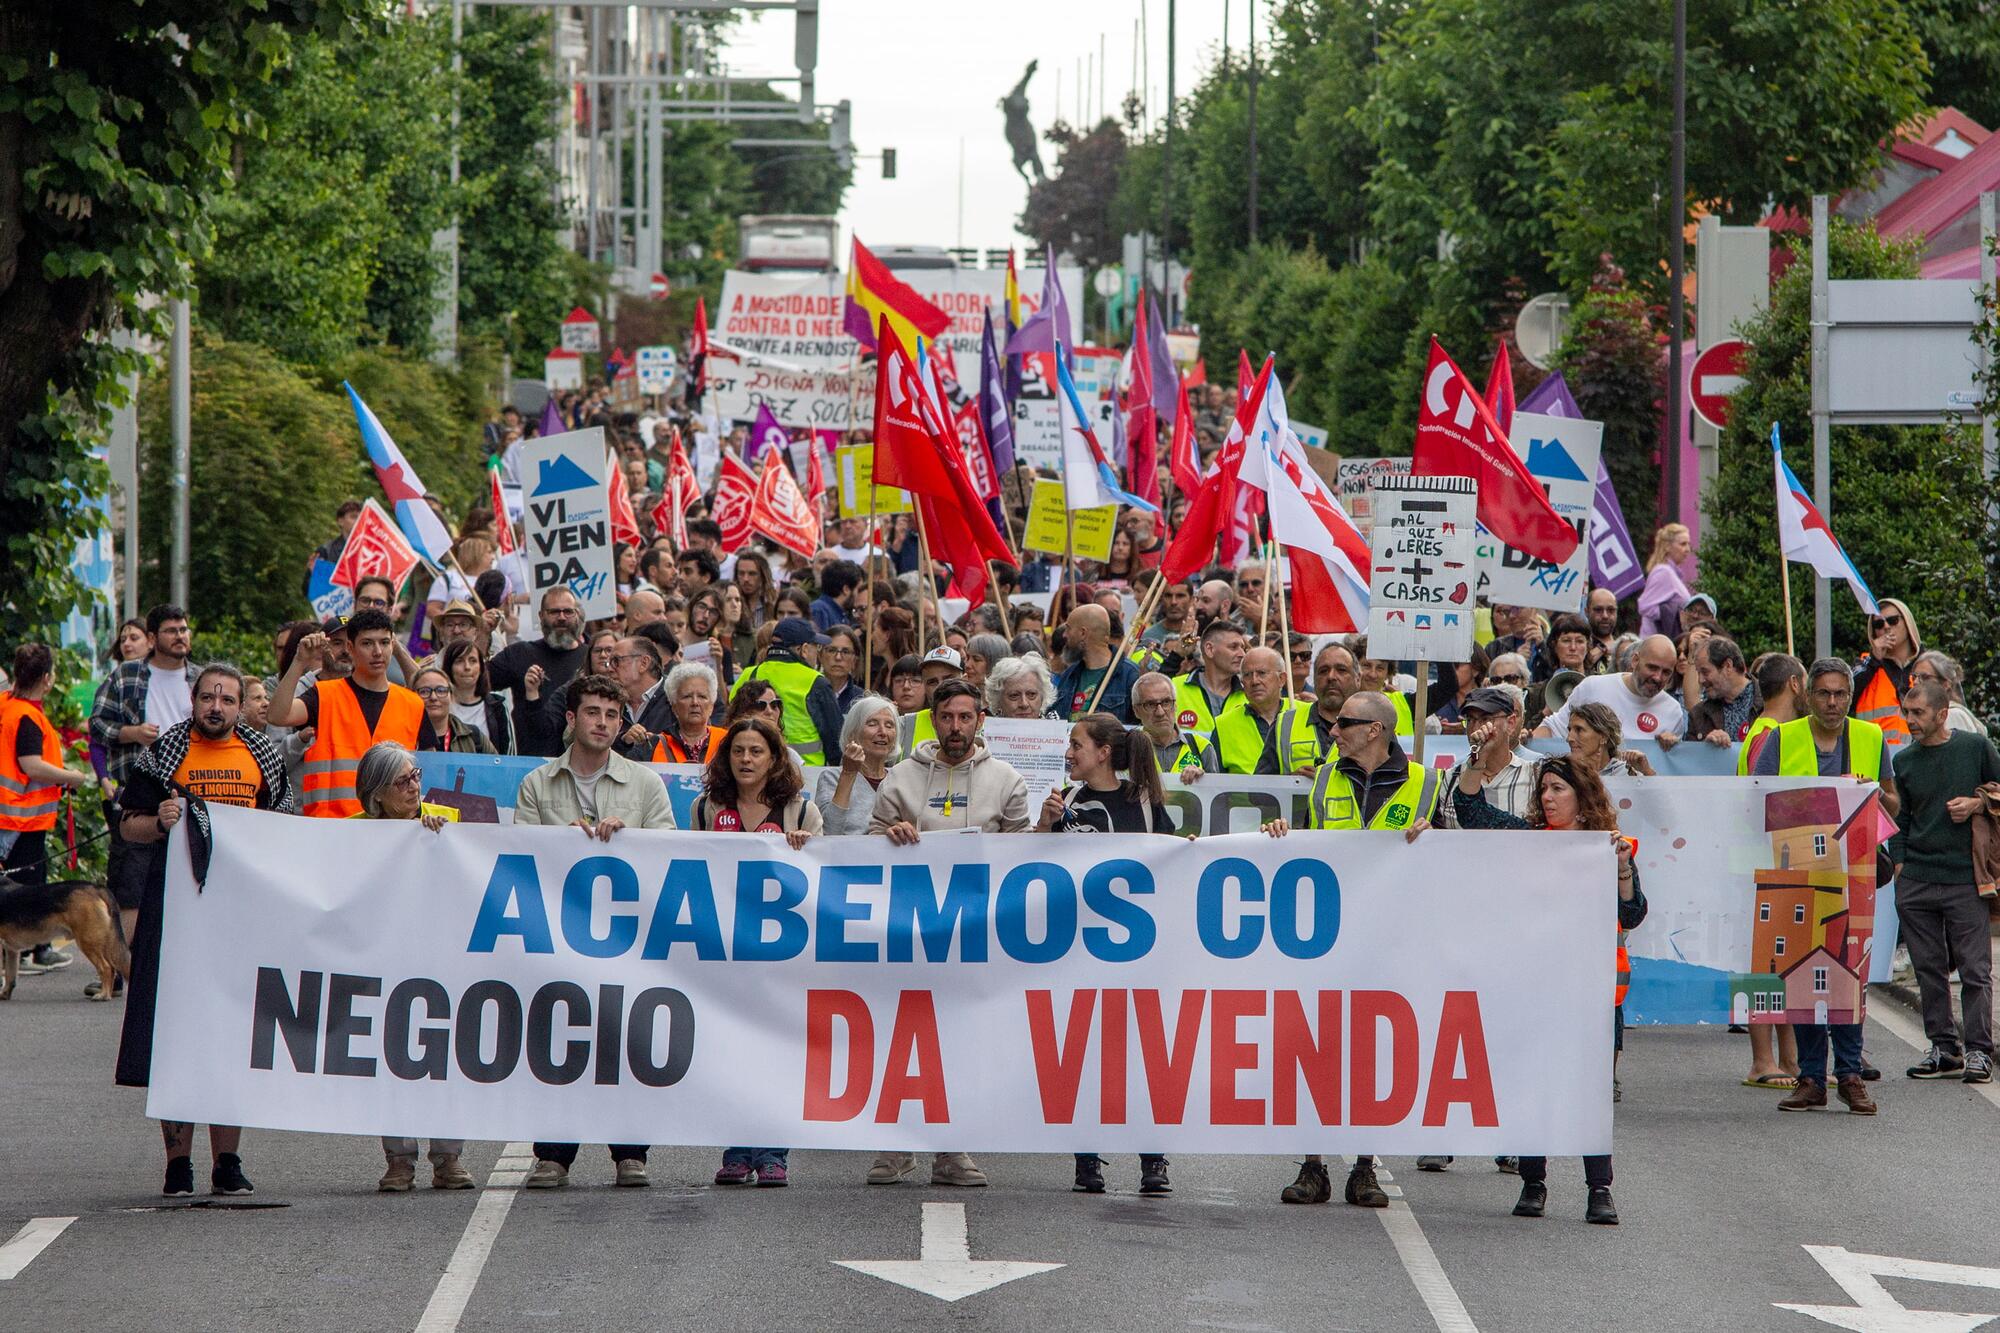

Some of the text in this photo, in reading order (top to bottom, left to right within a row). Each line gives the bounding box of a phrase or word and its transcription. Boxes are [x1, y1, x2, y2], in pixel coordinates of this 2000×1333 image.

[732, 294, 743, 313] A
[727, 316, 791, 336] CONTRA
[796, 317, 807, 337] O
[1340, 463, 1369, 478] CASAS
[1492, 456, 1515, 479] Galega
[530, 498, 566, 528] VI
[1408, 514, 1425, 526] AL
[532, 520, 606, 557] VEN
[1396, 539, 1443, 557] LERES
[535, 556, 589, 589] DA
[1383, 582, 1446, 603] CASAS
[188, 769, 242, 781] SINDICATO
[190, 784, 255, 798] DE INQUILINAS
[467, 853, 1342, 964] ACABEMOS CO
[251, 967, 1499, 1127] NEGOCIO DA VIVENDA
